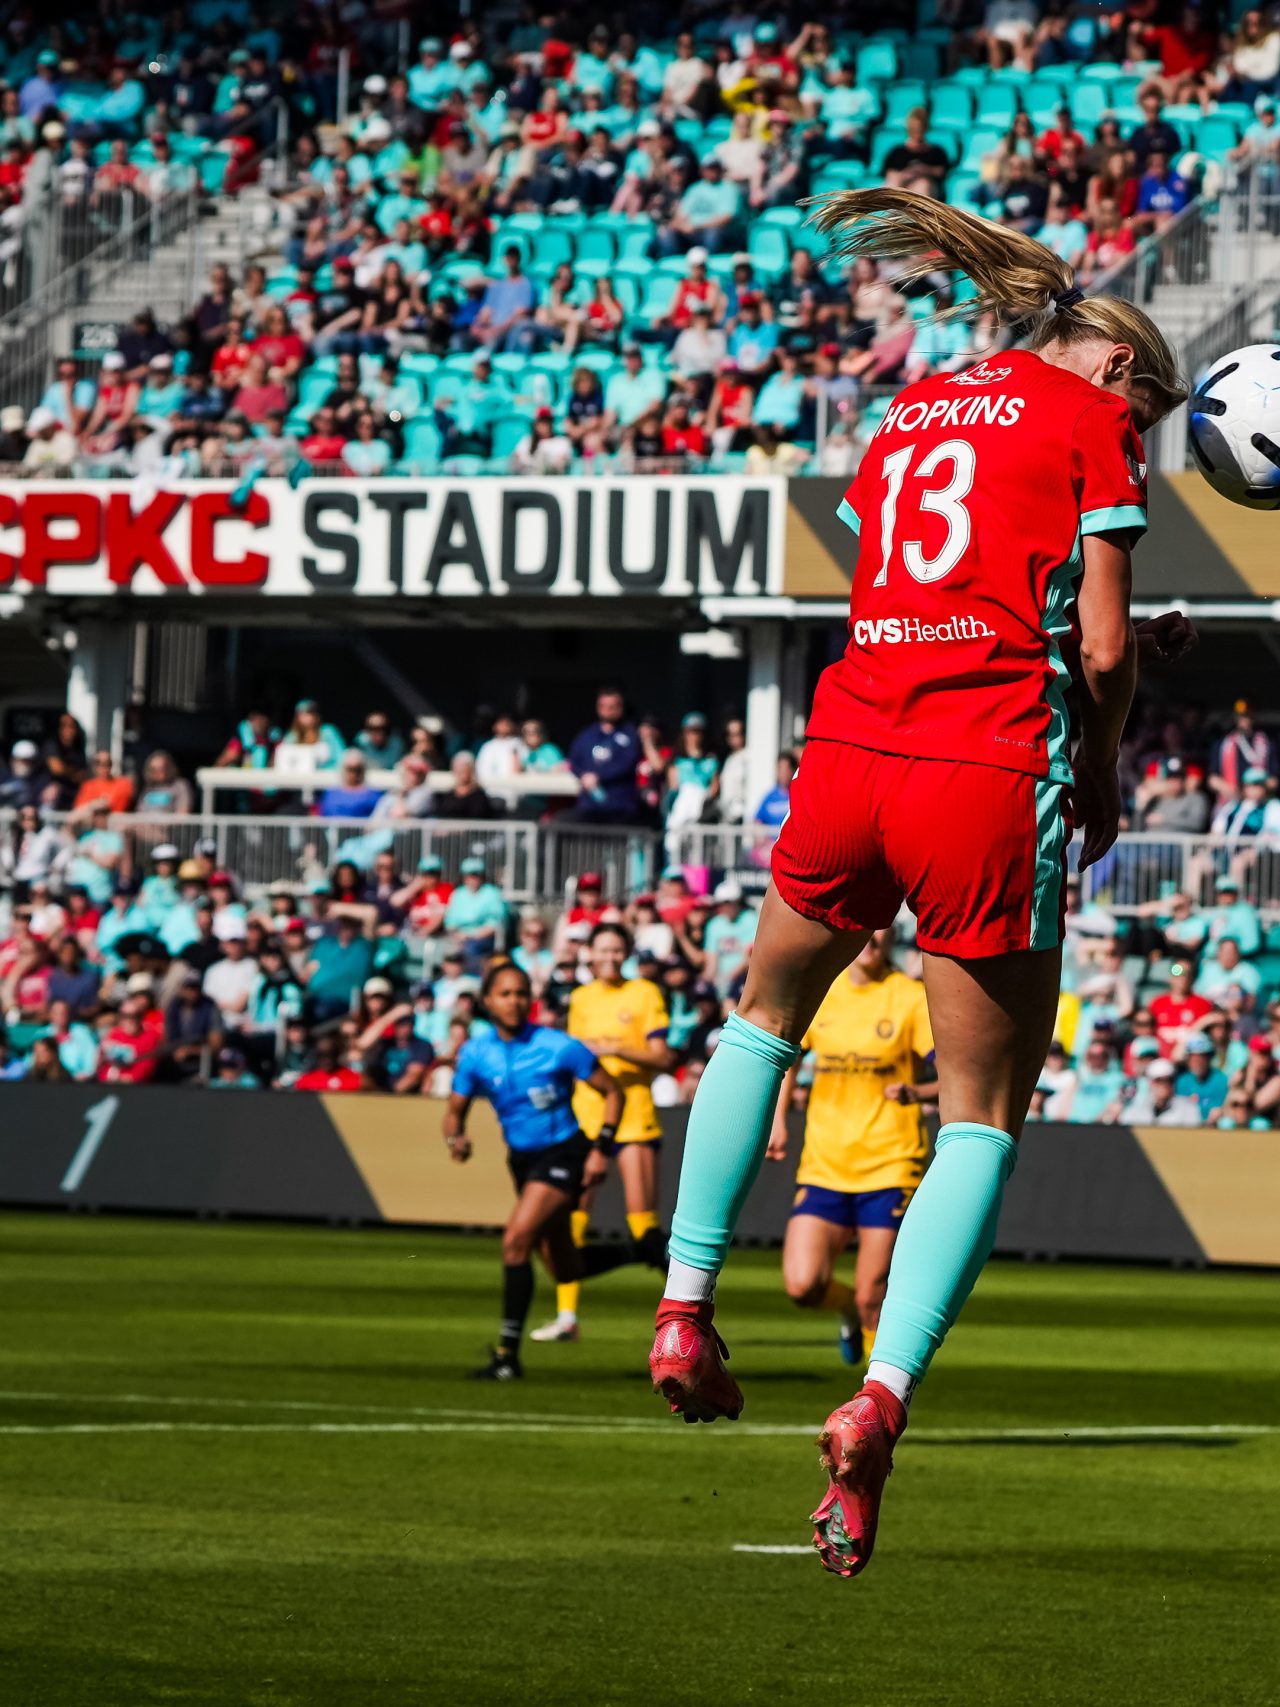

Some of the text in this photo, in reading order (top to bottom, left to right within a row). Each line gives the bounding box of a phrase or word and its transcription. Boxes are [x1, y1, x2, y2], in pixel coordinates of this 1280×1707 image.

[874, 394, 1026, 439] HOPKINS
[0, 488, 770, 592] PKC STADIUM
[873, 438, 977, 588] 13
[60, 1093, 119, 1191] 1
